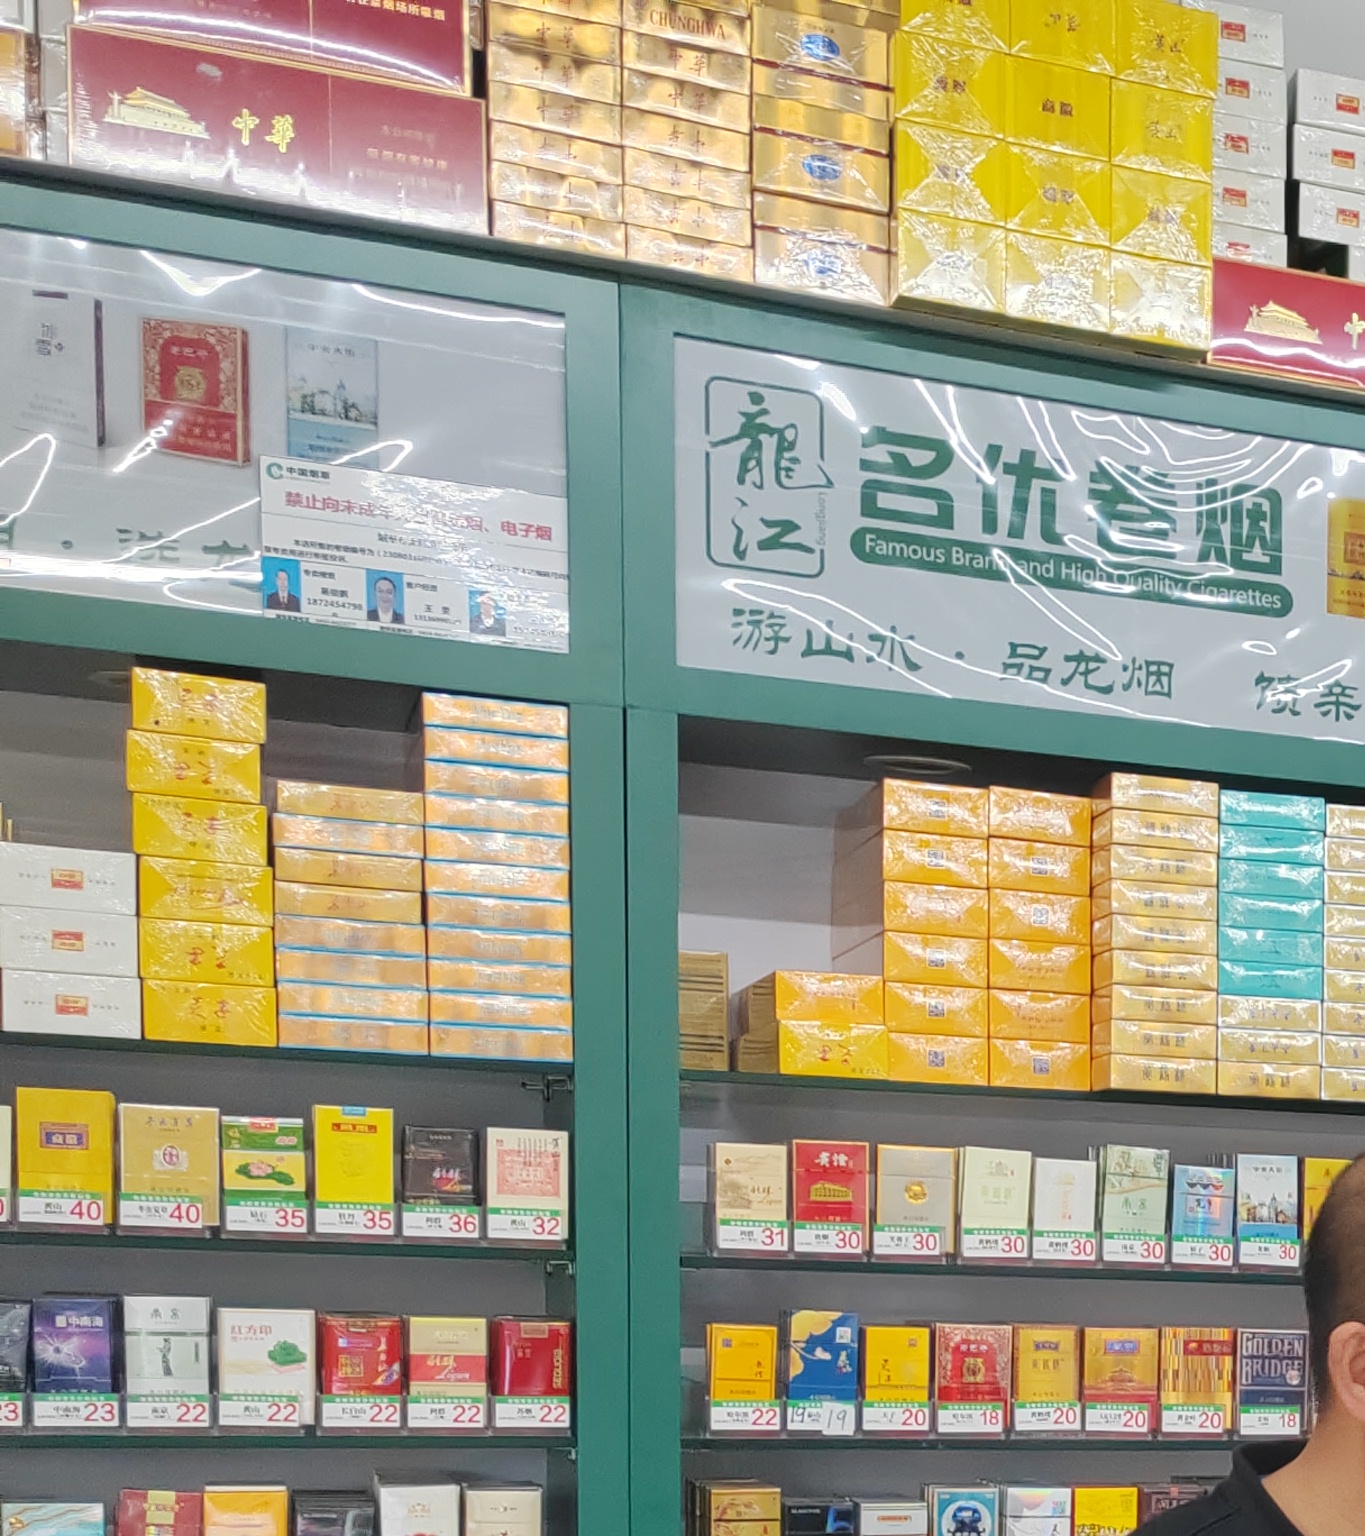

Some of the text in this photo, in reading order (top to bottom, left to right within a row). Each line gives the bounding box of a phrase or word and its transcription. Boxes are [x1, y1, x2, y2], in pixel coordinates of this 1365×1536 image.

[649, 9, 727, 40] CHUNGHWA
[859, 426, 1284, 578] 名优卷烟
[863, 533, 1283, 612] Famous Brand and High Quality Cigarettes
[69, 1200, 101, 1221] 40
[169, 1203, 201, 1223] 40
[275, 1208, 305, 1228] 35
[362, 1210, 392, 1230] 35
[448, 1214, 477, 1234] 36
[532, 1216, 560, 1236] 32
[760, 1228, 785, 1246] 31
[835, 1231, 861, 1249] 30
[912, 1233, 938, 1251] 30
[1001, 1236, 1026, 1253] 30
[1070, 1239, 1095, 1257] 30
[1140, 1241, 1164, 1259] 30
[1208, 1244, 1232, 1262] 30
[1278, 1245, 1297, 1260] 30
[1241, 1332, 1305, 1355] GOLDEN
[1241, 1358, 1304, 1384] BRIDGE
[84, 1402, 116, 1422] 23
[176, 1403, 208, 1423] 22
[267, 1403, 299, 1422] 22
[369, 1403, 398, 1423] 22
[452, 1405, 481, 1424] 22
[539, 1404, 566, 1423] 22
[751, 1408, 778, 1426] 22
[827, 1408, 848, 1429] 19
[901, 1408, 927, 1426] 20
[980, 1409, 999, 1426] 18
[1053, 1407, 1077, 1425] 20
[1122, 1410, 1146, 1428] 20
[1198, 1412, 1222, 1429] 20
[1278, 1413, 1297, 1429] 18
